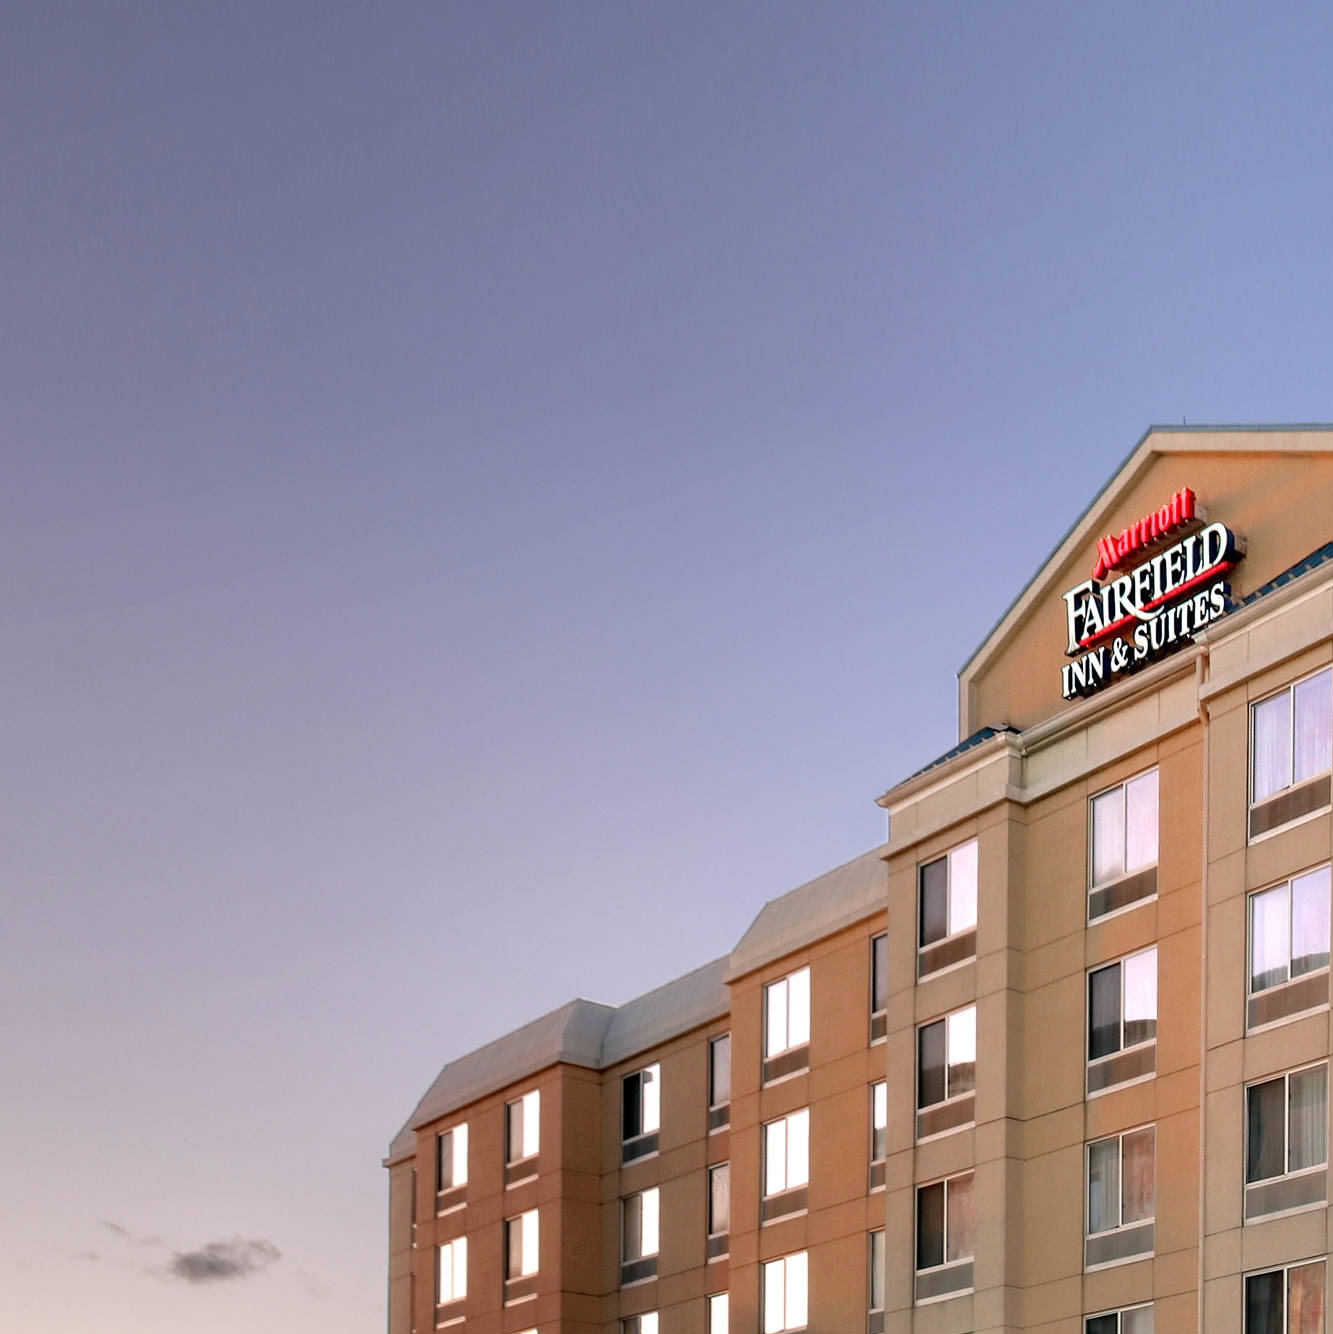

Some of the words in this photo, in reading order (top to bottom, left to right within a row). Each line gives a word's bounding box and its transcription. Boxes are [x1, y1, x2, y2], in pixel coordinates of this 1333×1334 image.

[1063, 521, 1231, 656] FAIRFIELD
[1092, 486, 1196, 580] Marriott
[1061, 646, 1106, 699] INN
[1110, 636, 1130, 674] &
[1133, 580, 1228, 663] SUITES
